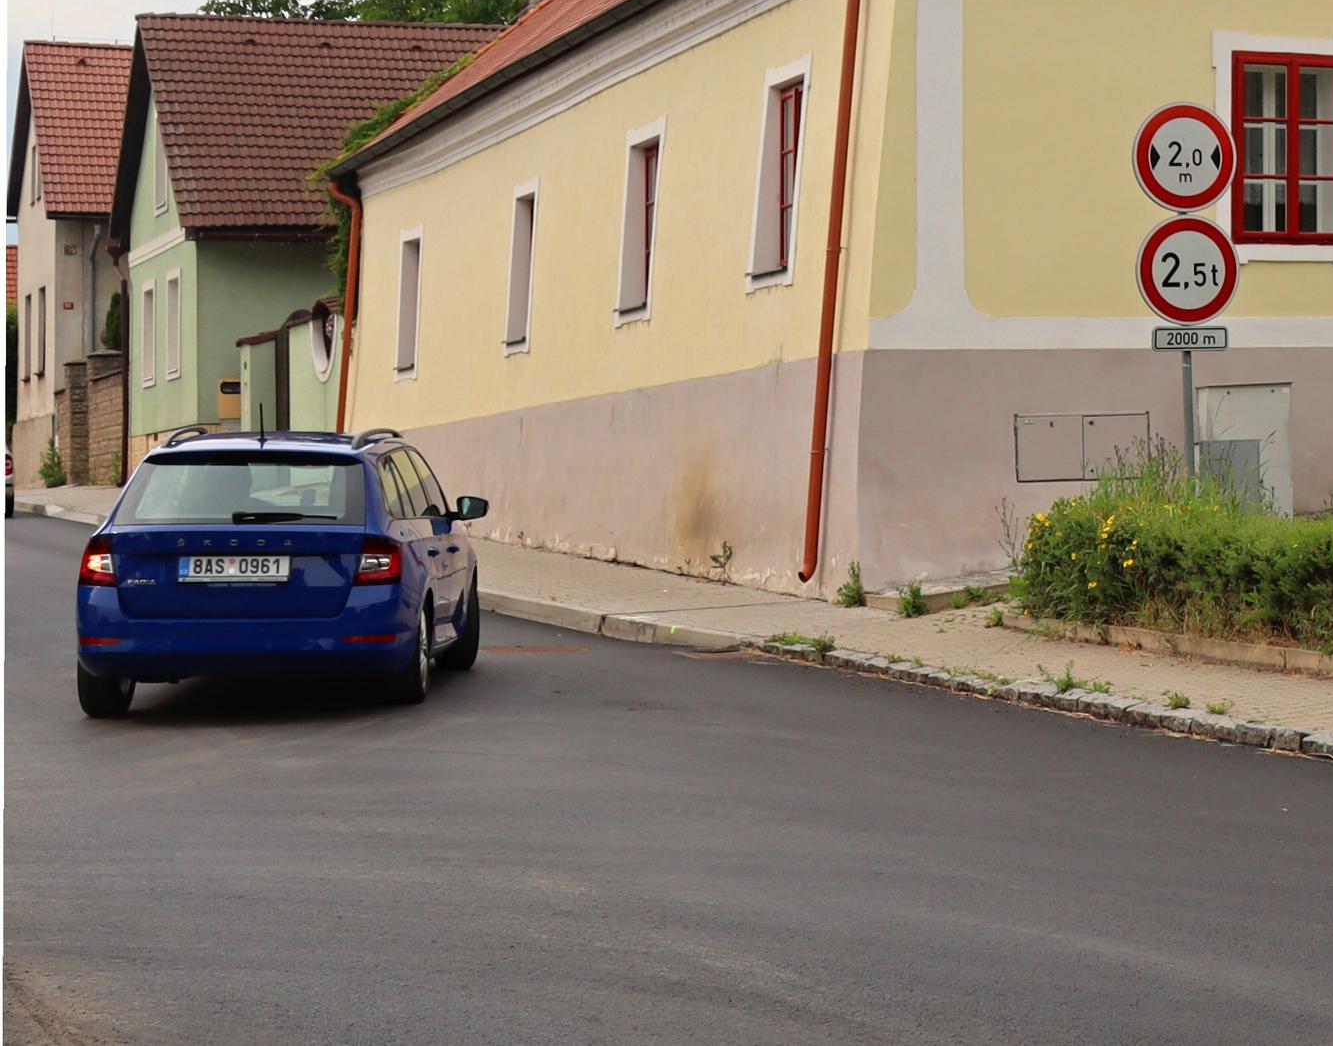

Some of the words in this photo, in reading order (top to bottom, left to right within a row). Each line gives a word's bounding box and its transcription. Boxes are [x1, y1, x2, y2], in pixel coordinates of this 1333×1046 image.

[1168, 141, 1203, 168] 2,0
[1178, 172, 1193, 183] m
[1166, 332, 1199, 346] 2000
[1202, 335, 1216, 345] m
[193, 558, 225, 574] 8AS
[239, 558, 280, 574] 0961
